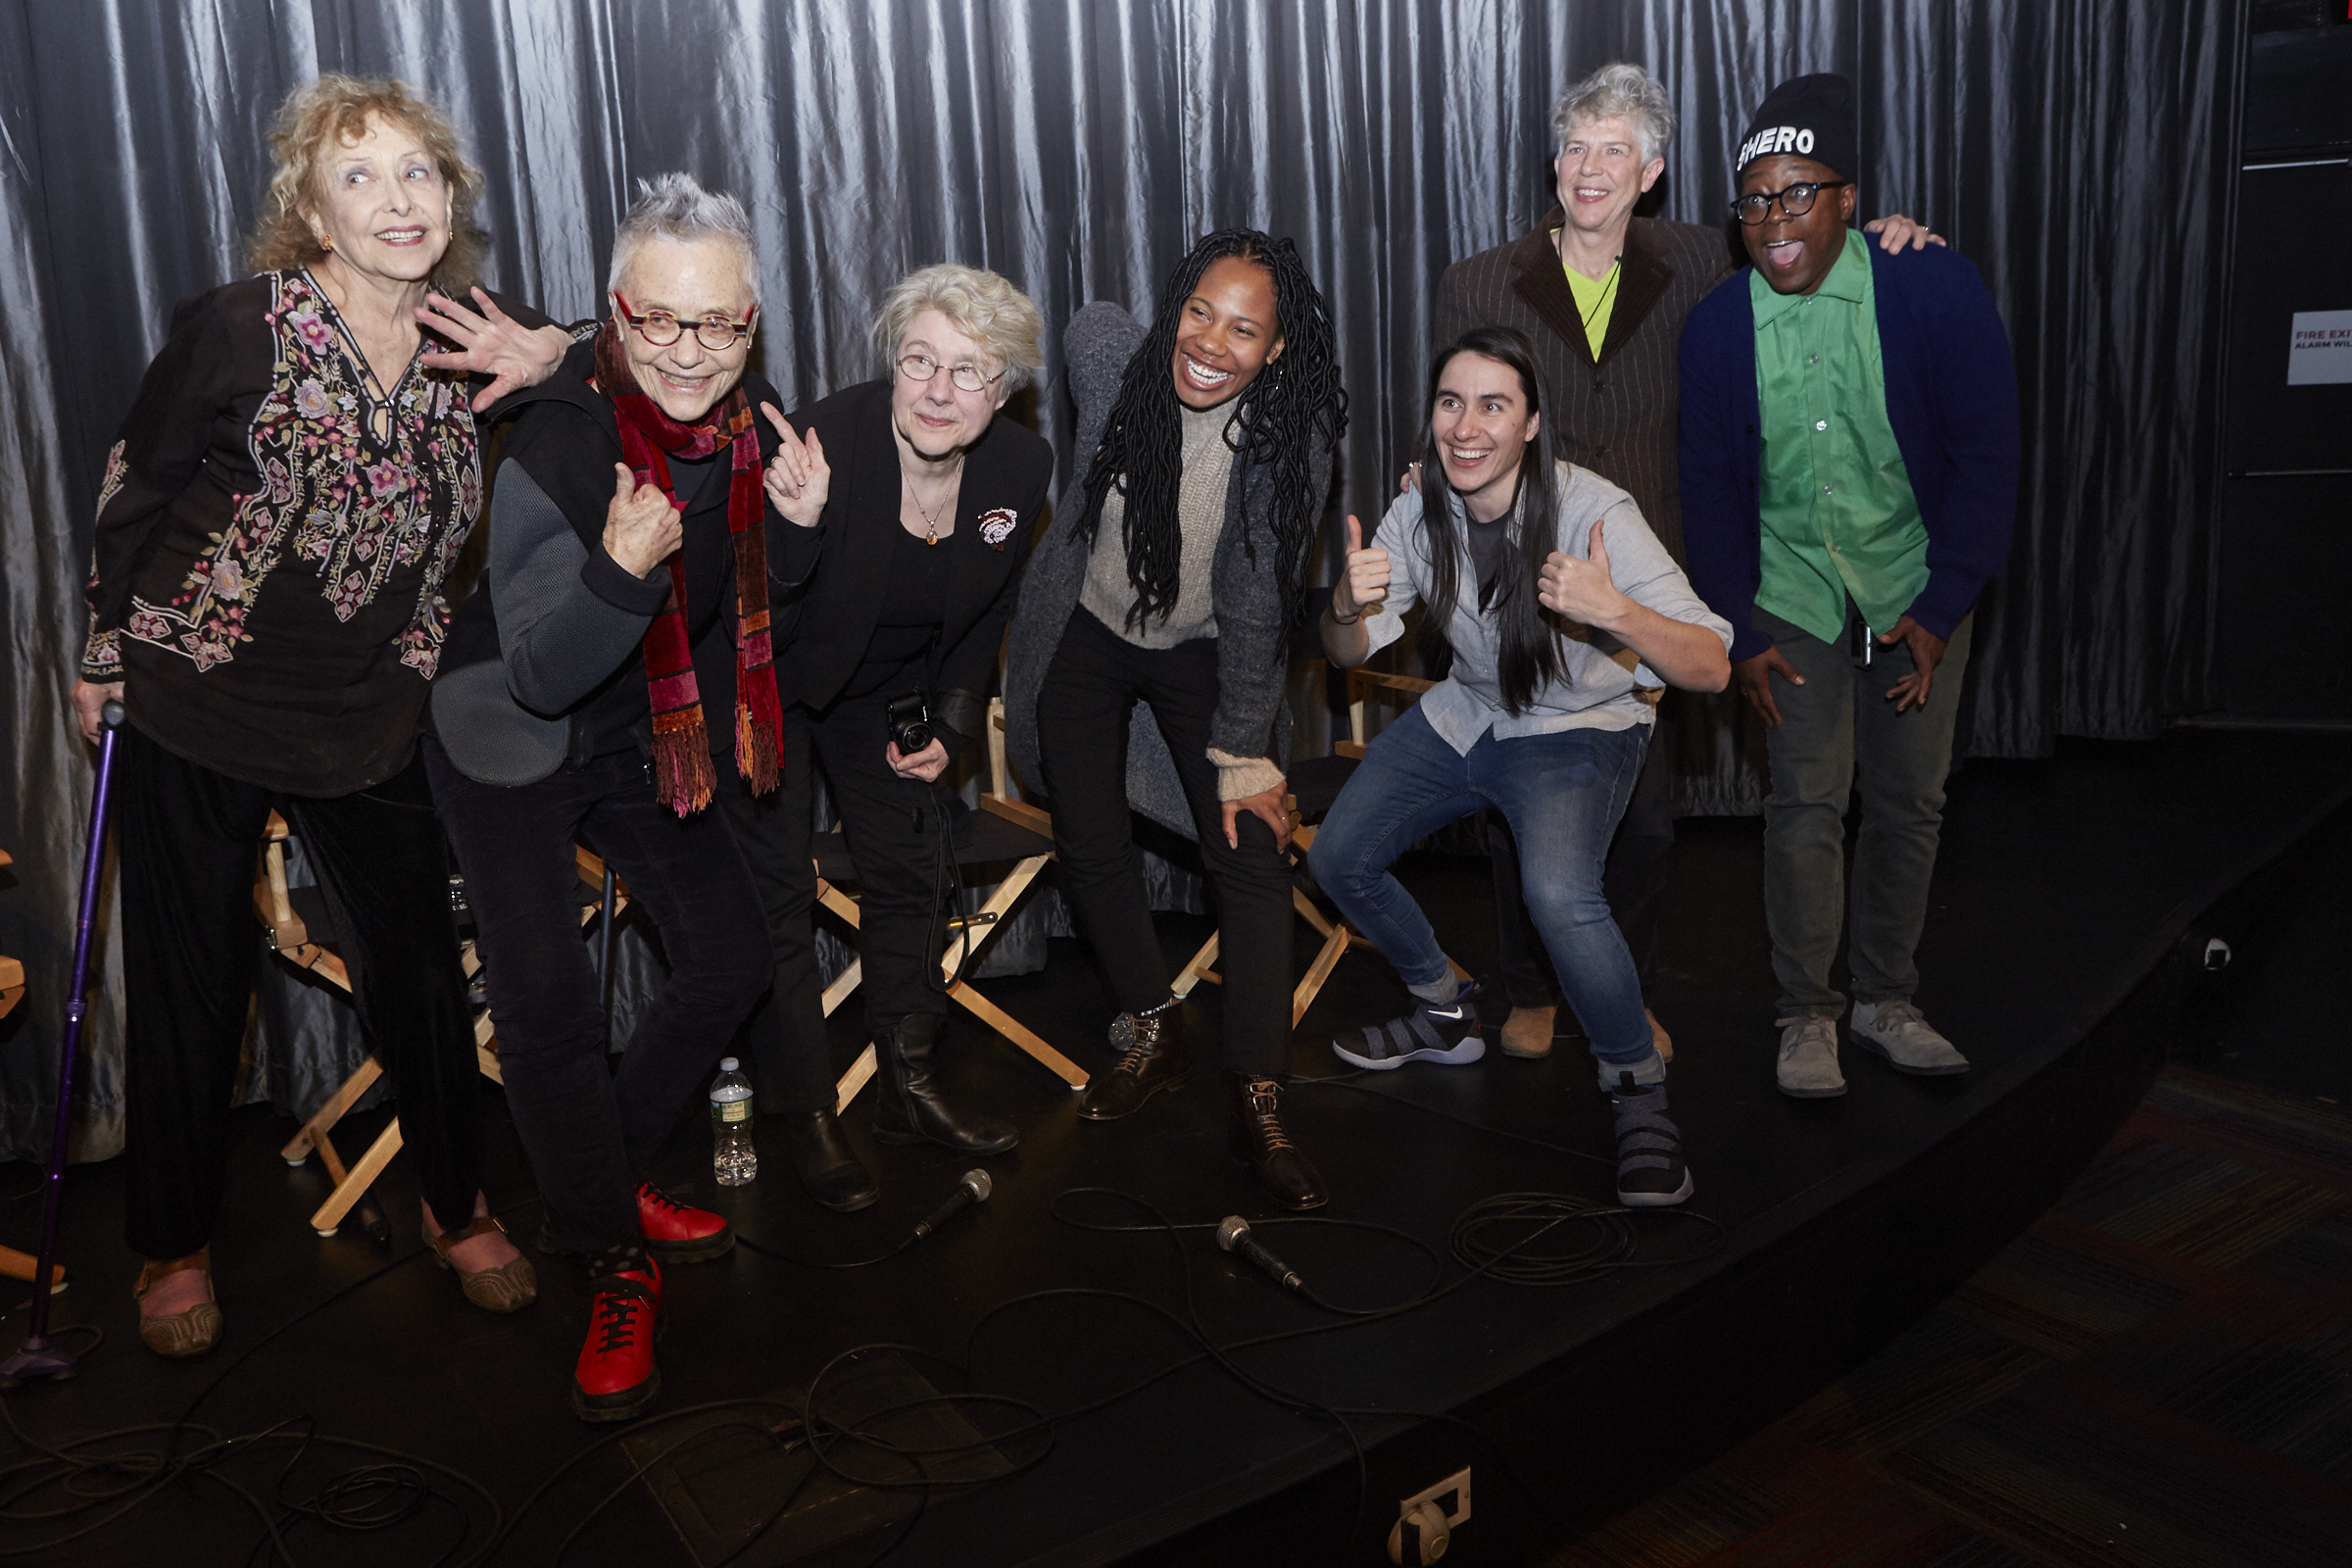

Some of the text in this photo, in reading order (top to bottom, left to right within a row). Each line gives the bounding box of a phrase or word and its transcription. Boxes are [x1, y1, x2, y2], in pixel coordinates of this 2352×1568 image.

[1737, 125, 1814, 172] SHERO
[2296, 329, 2352, 339] FIRE EXI
